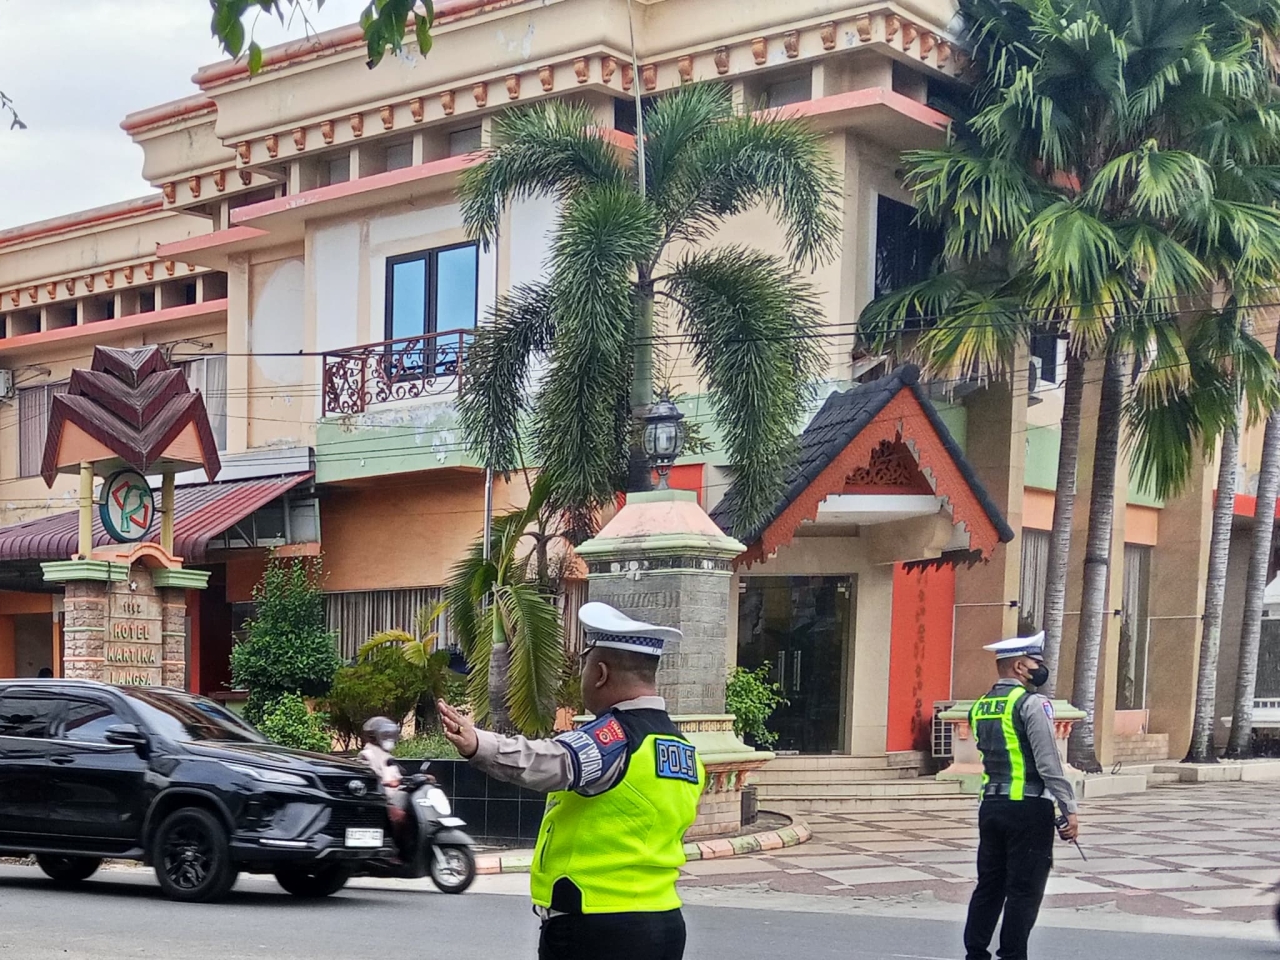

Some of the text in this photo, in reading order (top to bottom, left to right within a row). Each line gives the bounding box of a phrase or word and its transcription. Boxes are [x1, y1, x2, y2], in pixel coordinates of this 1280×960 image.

[113, 622, 149, 640] HOTEL
[107, 646, 156, 664] KARTIKA
[110, 671, 153, 686] LANGSA
[556, 730, 603, 787] ATWAL
